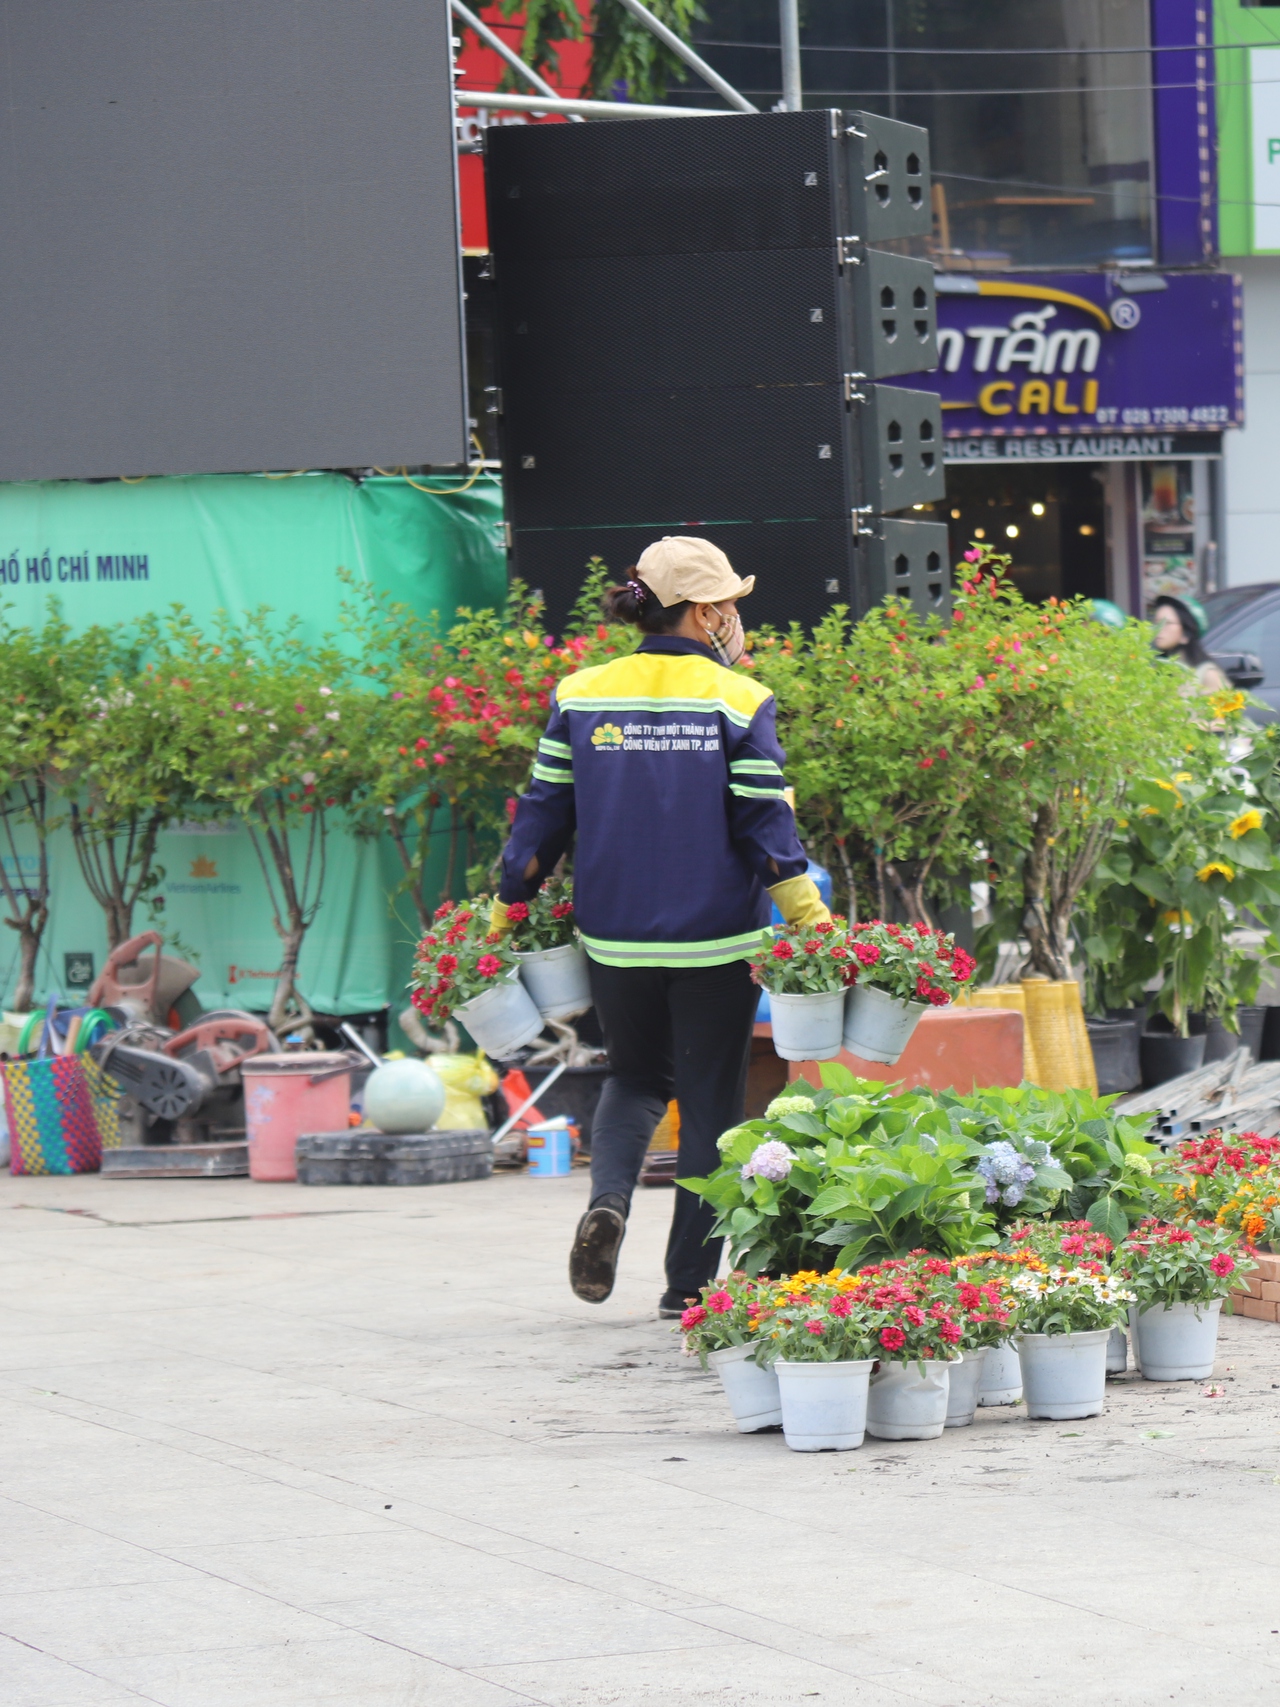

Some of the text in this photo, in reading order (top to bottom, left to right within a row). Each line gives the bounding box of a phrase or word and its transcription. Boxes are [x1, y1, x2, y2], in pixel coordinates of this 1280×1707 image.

[979, 378, 1099, 415] CALI
[1004, 436, 1175, 456] RESTAURANT
[57, 550, 89, 583] CHÍ
[96, 554, 149, 582] MINH
[623, 723, 643, 736] CÔNG
[643, 724, 653, 736] TY
[666, 723, 681, 738] MỘT
[682, 723, 705, 736] THÀNH
[623, 737, 643, 751] CÔNG
[644, 737, 660, 752] VIÊN
[671, 739, 690, 751] XANH
[691, 739, 703, 751] TP.
